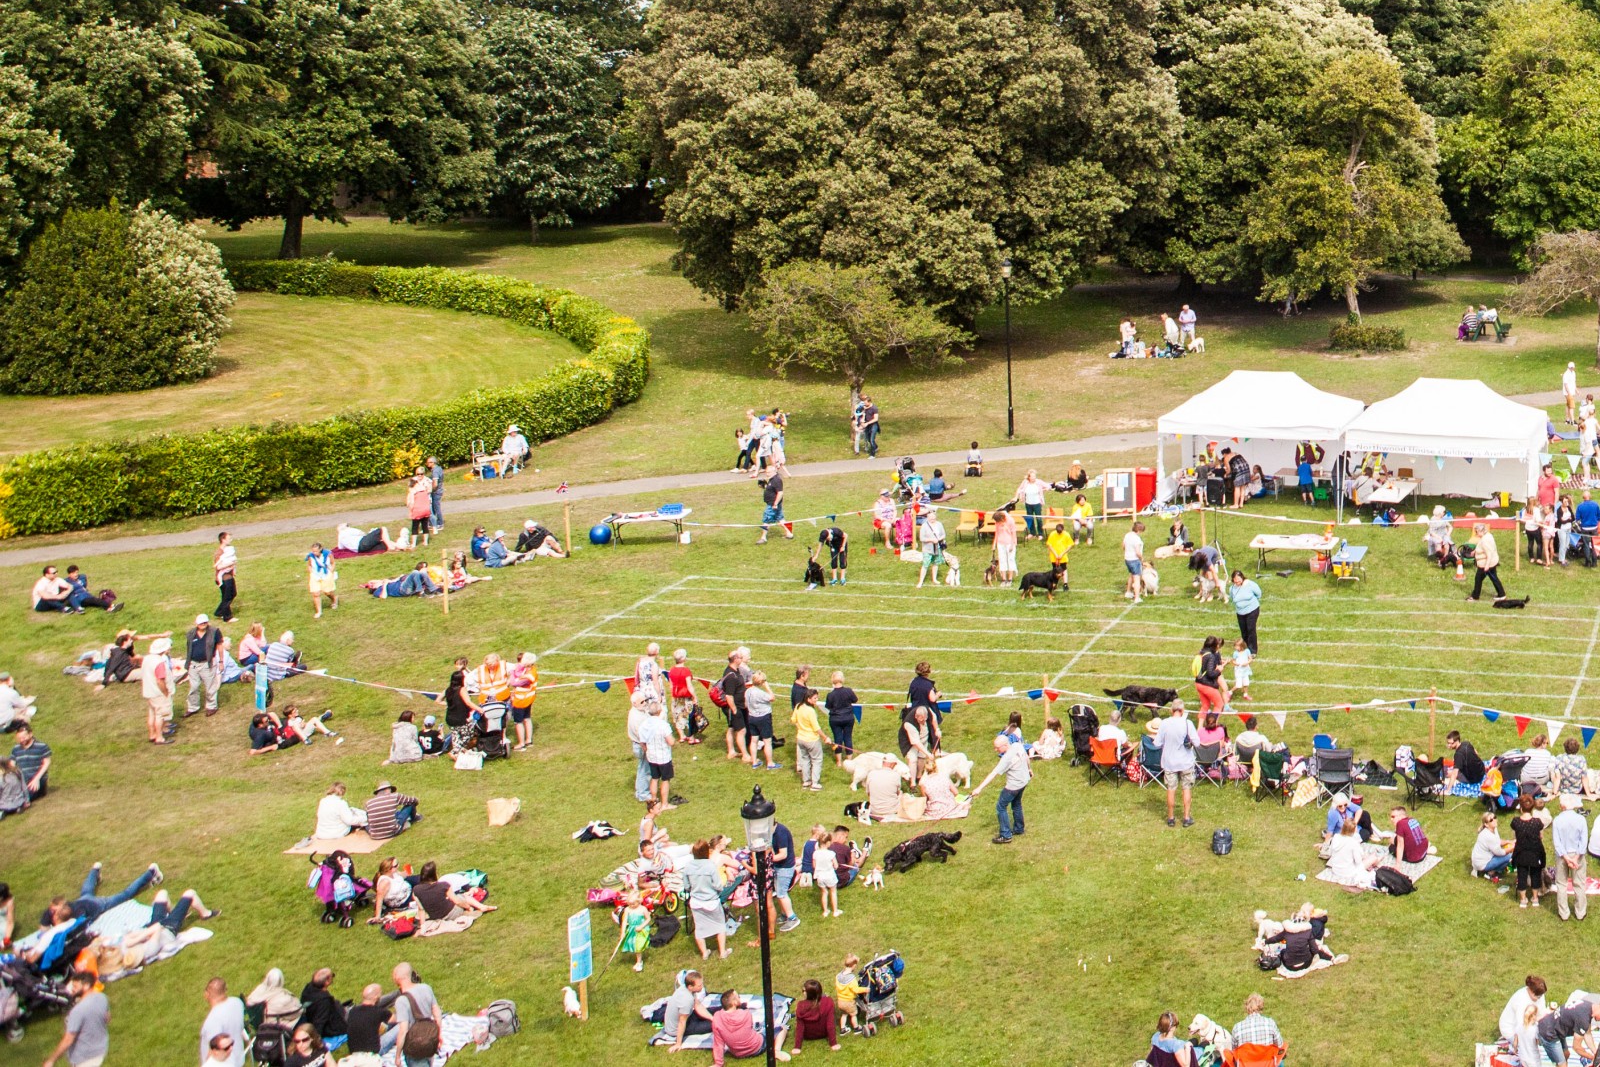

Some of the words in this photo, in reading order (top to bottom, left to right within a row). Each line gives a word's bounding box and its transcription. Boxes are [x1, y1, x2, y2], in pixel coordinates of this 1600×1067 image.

[1355, 443, 1406, 452] Northwood
[1408, 445, 1434, 454] House
[1484, 449, 1510, 457] Arena
